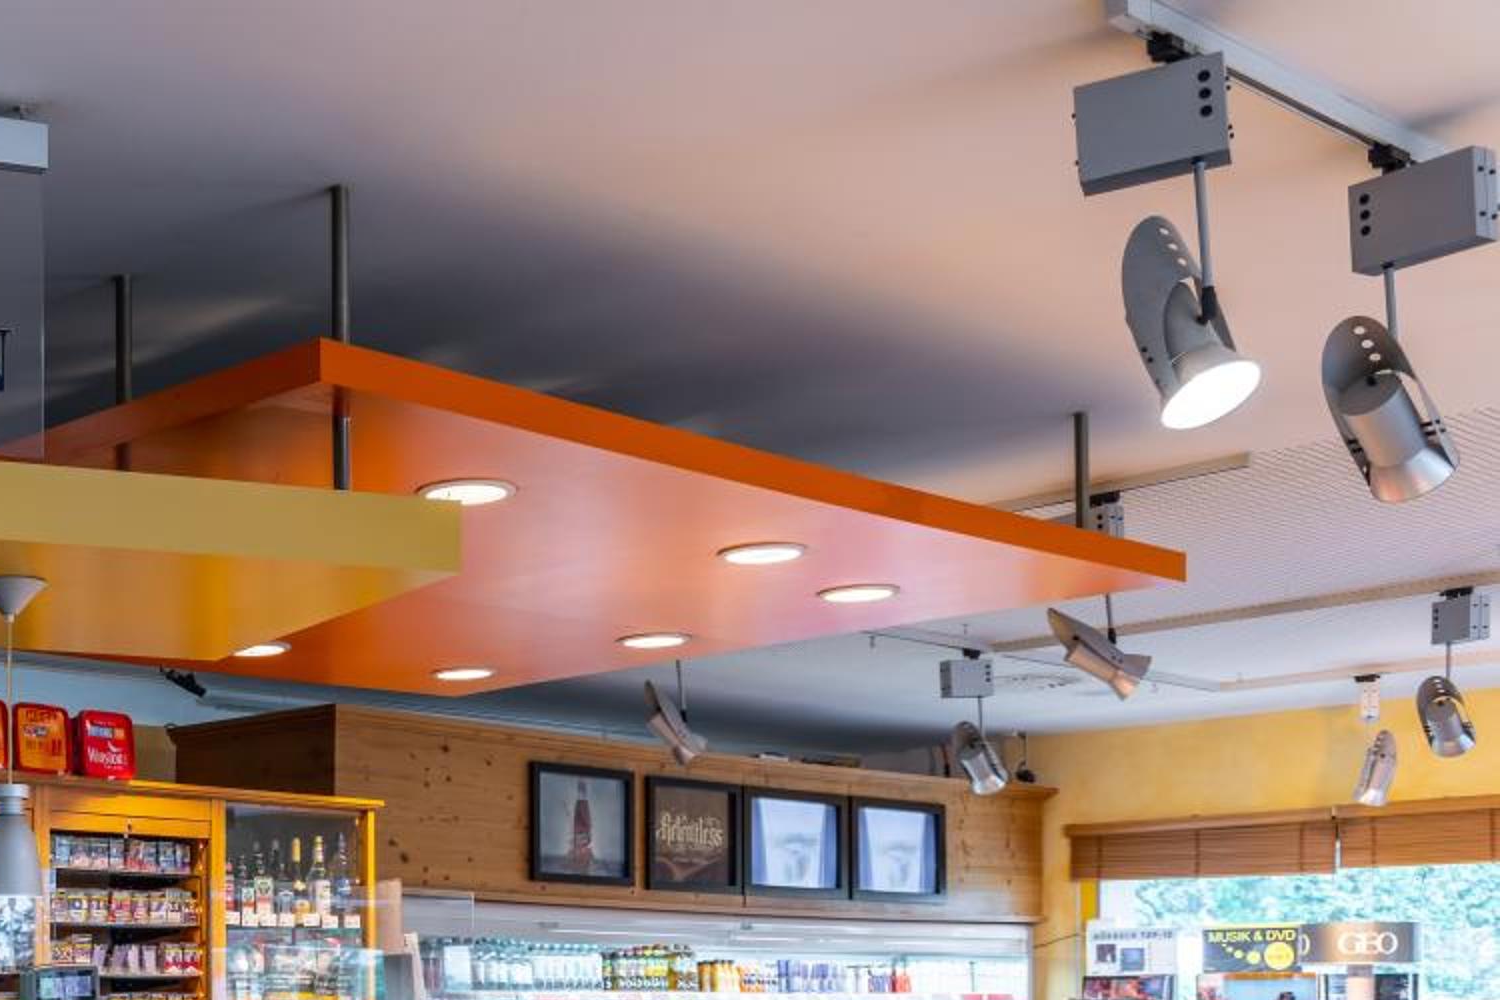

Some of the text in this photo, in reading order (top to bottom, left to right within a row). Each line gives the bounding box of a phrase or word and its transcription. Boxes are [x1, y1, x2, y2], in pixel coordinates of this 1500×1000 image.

[1208, 929, 1297, 943] MUSIK & DVD
[1337, 931, 1398, 955] GEO
